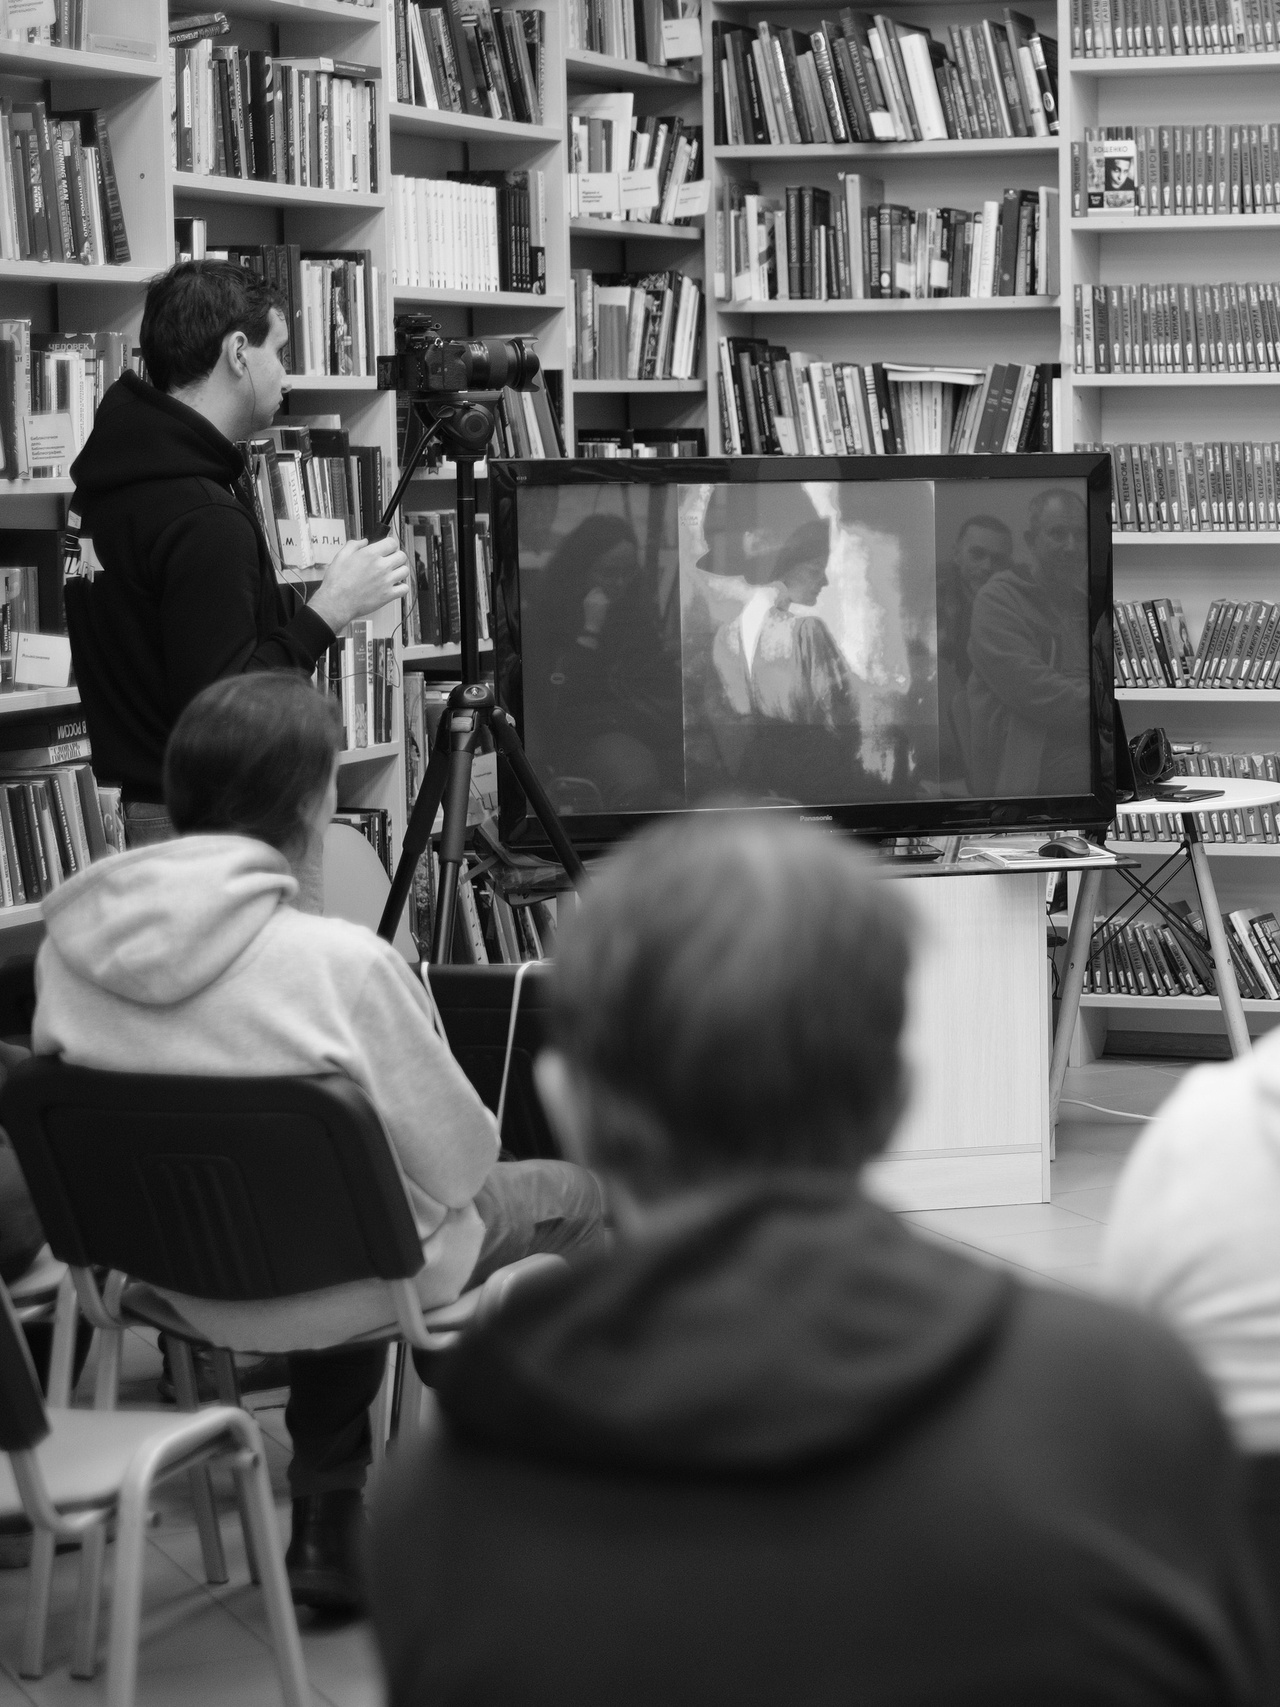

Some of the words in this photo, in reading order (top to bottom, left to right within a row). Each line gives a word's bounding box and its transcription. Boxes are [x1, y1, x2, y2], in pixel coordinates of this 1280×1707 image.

[848, 41, 863, 72] РОССИИ
[859, 84, 873, 112] КРЕСТ
[56, 139, 67, 178] RUNNING
[1150, 148, 1158, 184] КИРОВ
[60, 180, 70, 201] MAN
[77, 175, 87, 215] РОМАНЦЕВ
[1084, 307, 1092, 342] МАРАТ
[1171, 305, 1179, 340] НАХИМОВ
[1252, 310, 1262, 339] ОРУЭЛЛ
[48, 343, 90, 352] ЧЕЛОВЕК
[1121, 462, 1130, 502] РЕЗЕРФОРД
[1157, 468, 1166, 500] РОЗАНОВ
[322, 536, 344, 546] Л.Н.
[57, 722, 82, 740] РОССИИ
[82, 720, 87, 734] В
